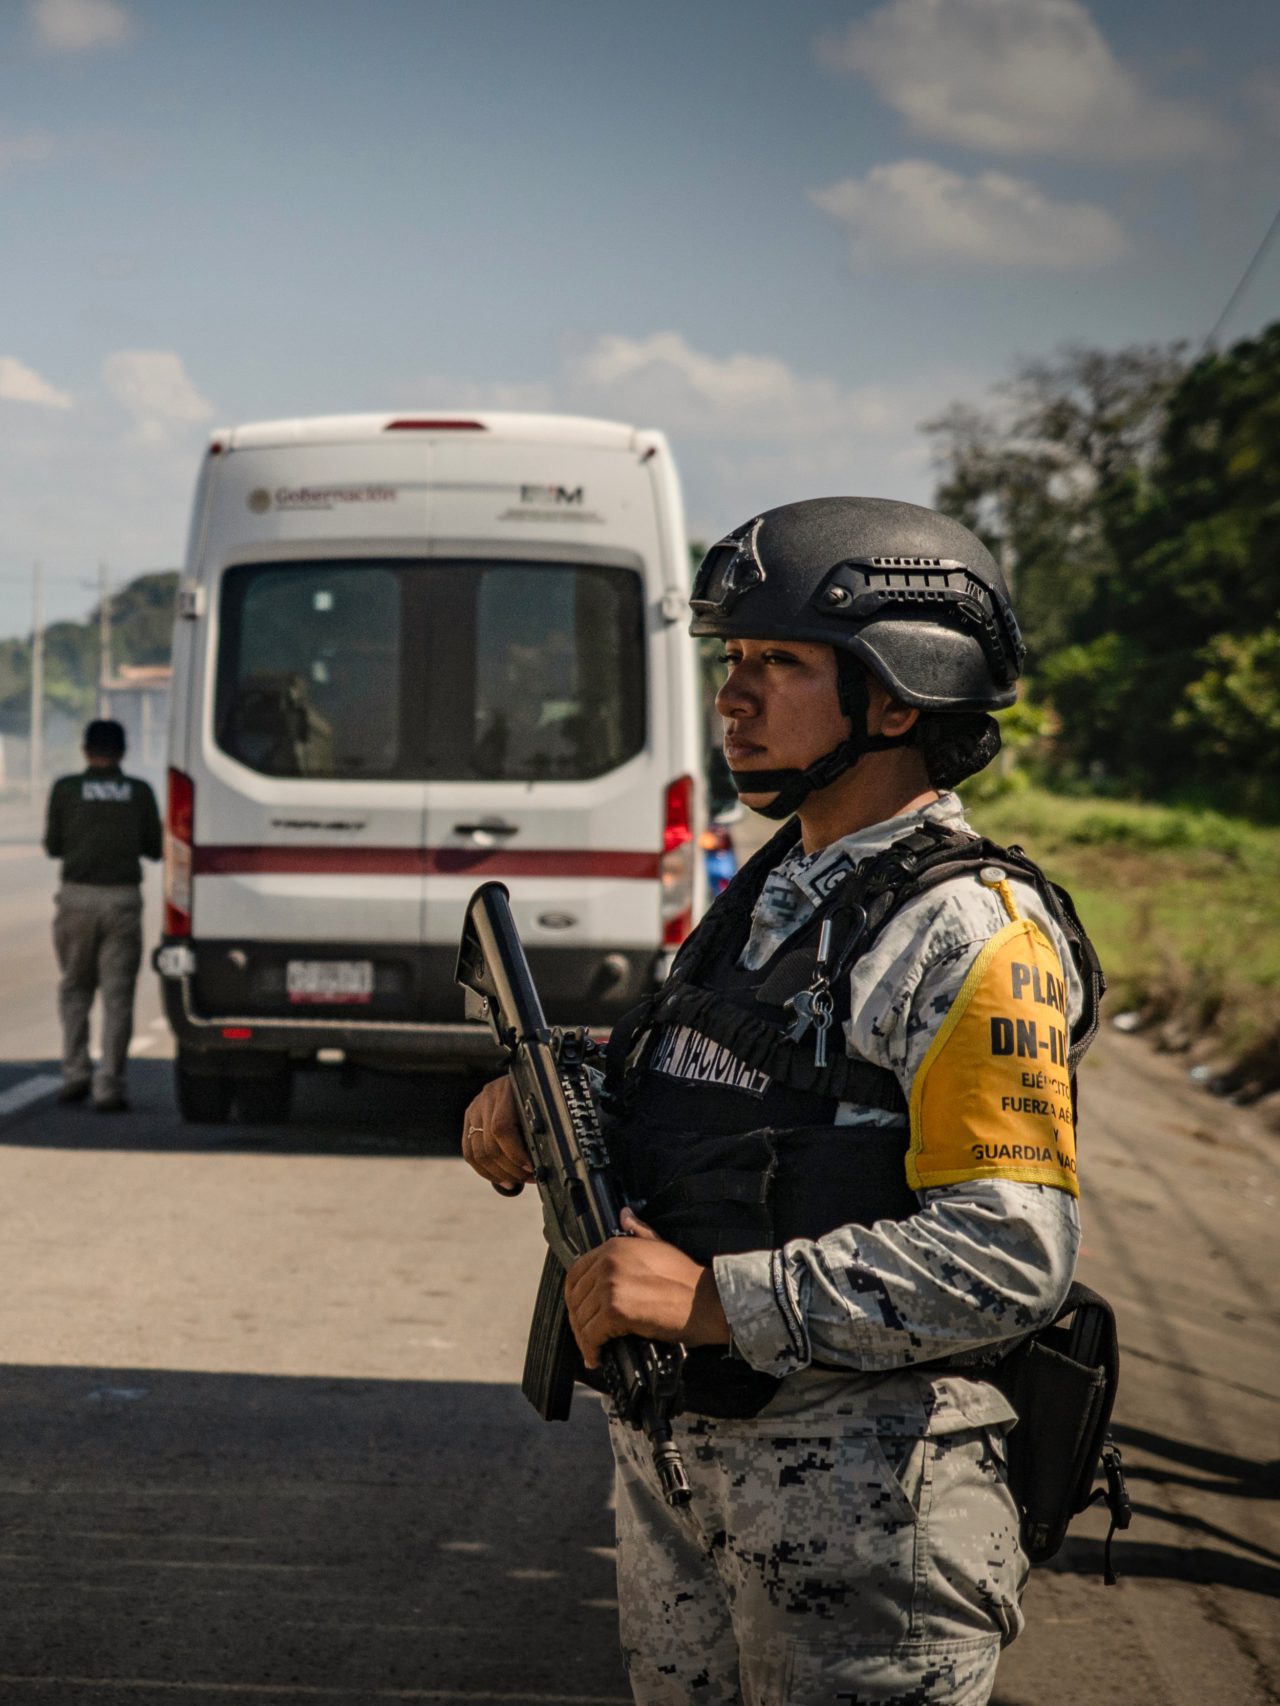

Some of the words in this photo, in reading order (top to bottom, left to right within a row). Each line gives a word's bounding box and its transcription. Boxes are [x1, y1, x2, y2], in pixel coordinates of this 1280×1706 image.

[1002, 1096, 1056, 1118] FUERZA
[1053, 1128, 1059, 1142] Y
[972, 1143, 1052, 1162] GUARDIA
